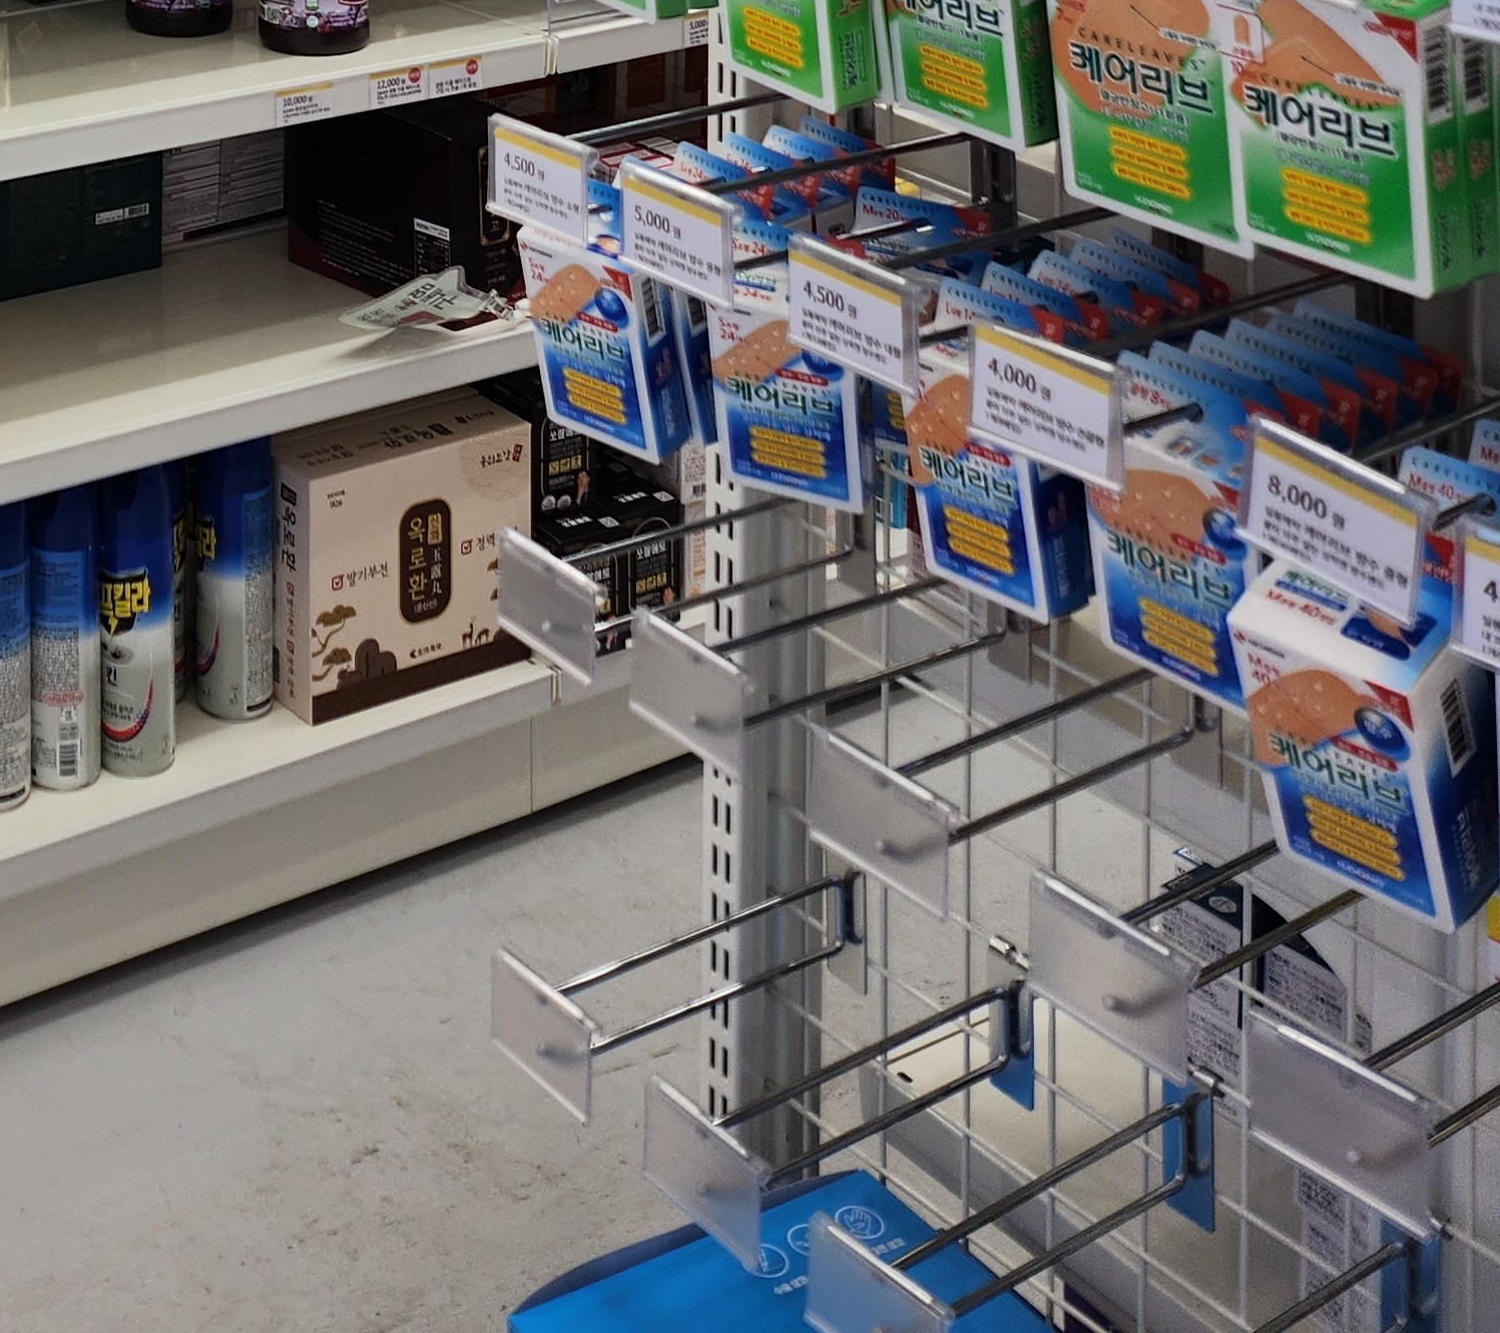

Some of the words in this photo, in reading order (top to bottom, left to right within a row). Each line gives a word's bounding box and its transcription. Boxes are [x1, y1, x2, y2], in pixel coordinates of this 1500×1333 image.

[1069, 40, 1215, 114] 케어리브
[1244, 85, 1397, 159] 케어리브
[634, 204, 671, 234] 5,000
[541, 317, 626, 361] 케어리브
[726, 376, 836, 417] 케어리브
[988, 357, 1038, 393] 4,000
[920, 444, 1017, 503] 케어리브
[346, 562, 389, 586] 발기부전
[408, 515, 428, 602] 옥로환
[1107, 526, 1232, 601] 케어리브
[1269, 732, 1401, 803] 케어리브
